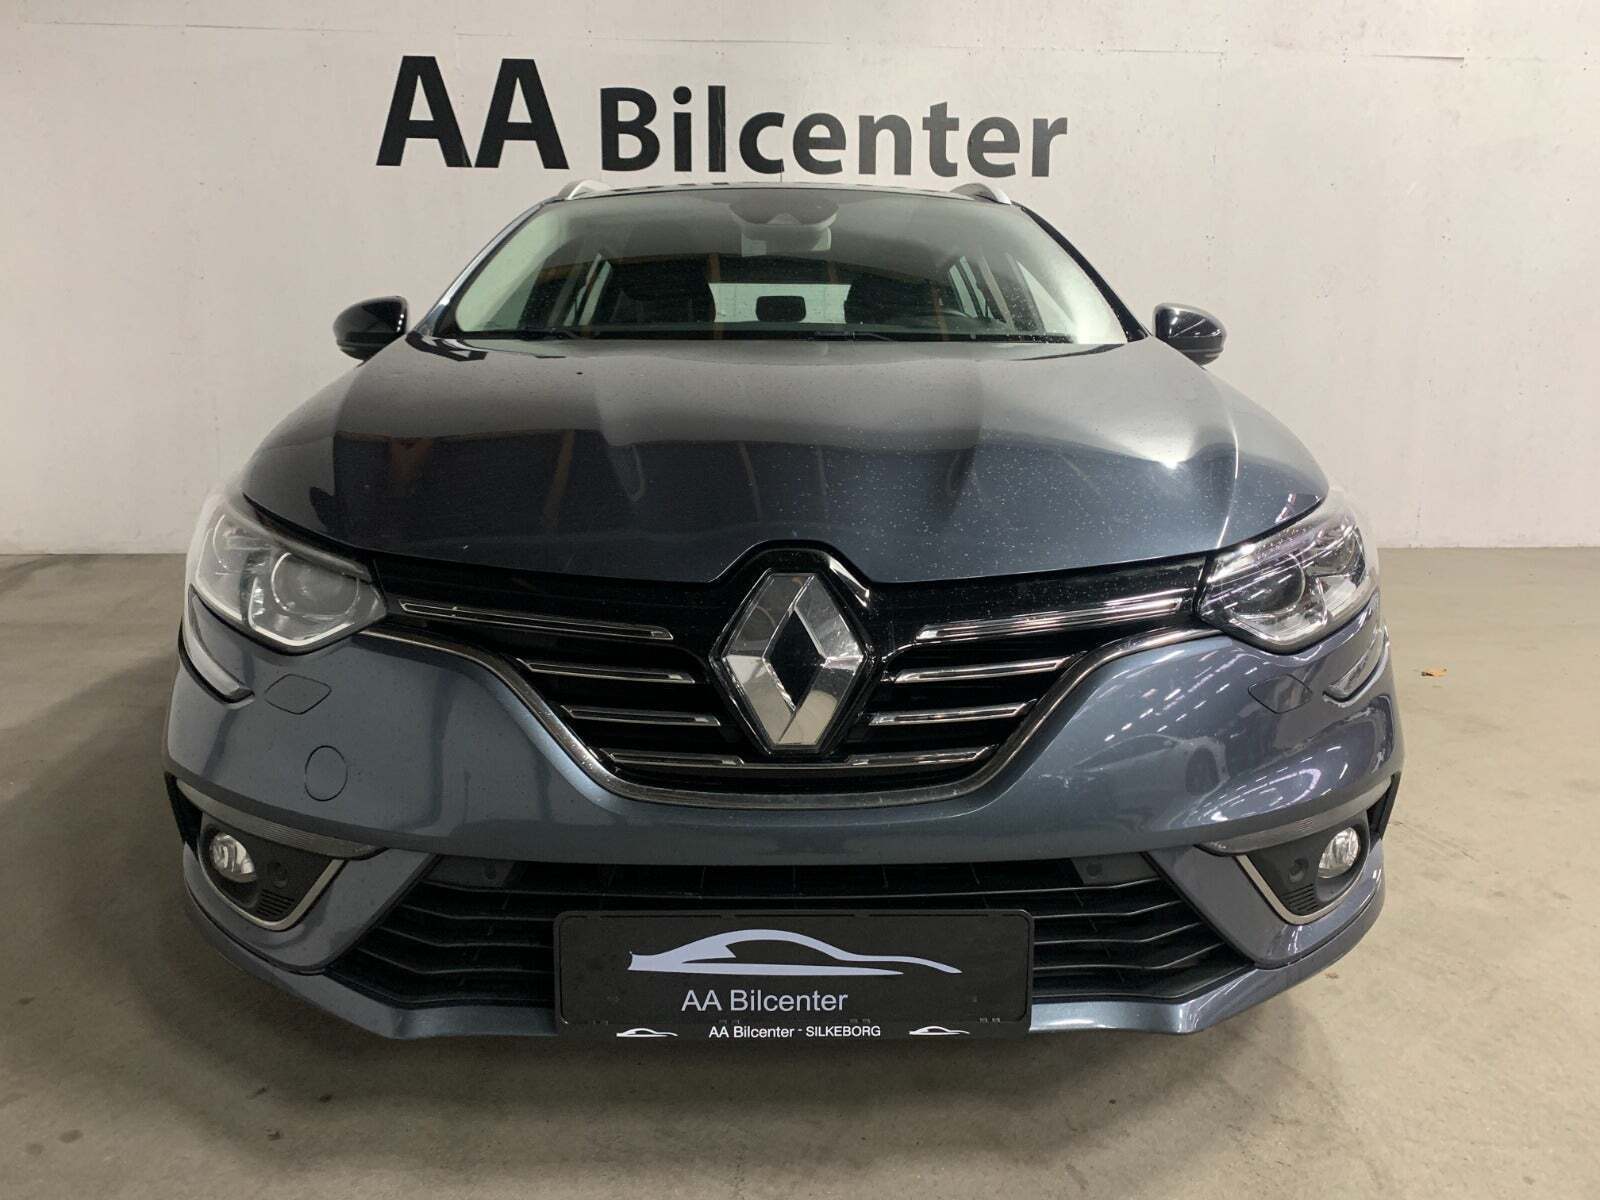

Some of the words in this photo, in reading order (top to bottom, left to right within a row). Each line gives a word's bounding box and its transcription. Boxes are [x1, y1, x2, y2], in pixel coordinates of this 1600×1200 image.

[375, 55, 570, 170] AA
[600, 85, 1068, 178] Bilcenter
[681, 989, 723, 1012] AA
[730, 989, 849, 1012] Bilcenter
[708, 1025, 730, 1039] AA
[733, 1025, 796, 1039] Bilcenter
[805, 1025, 881, 1038] SILKEBORG
